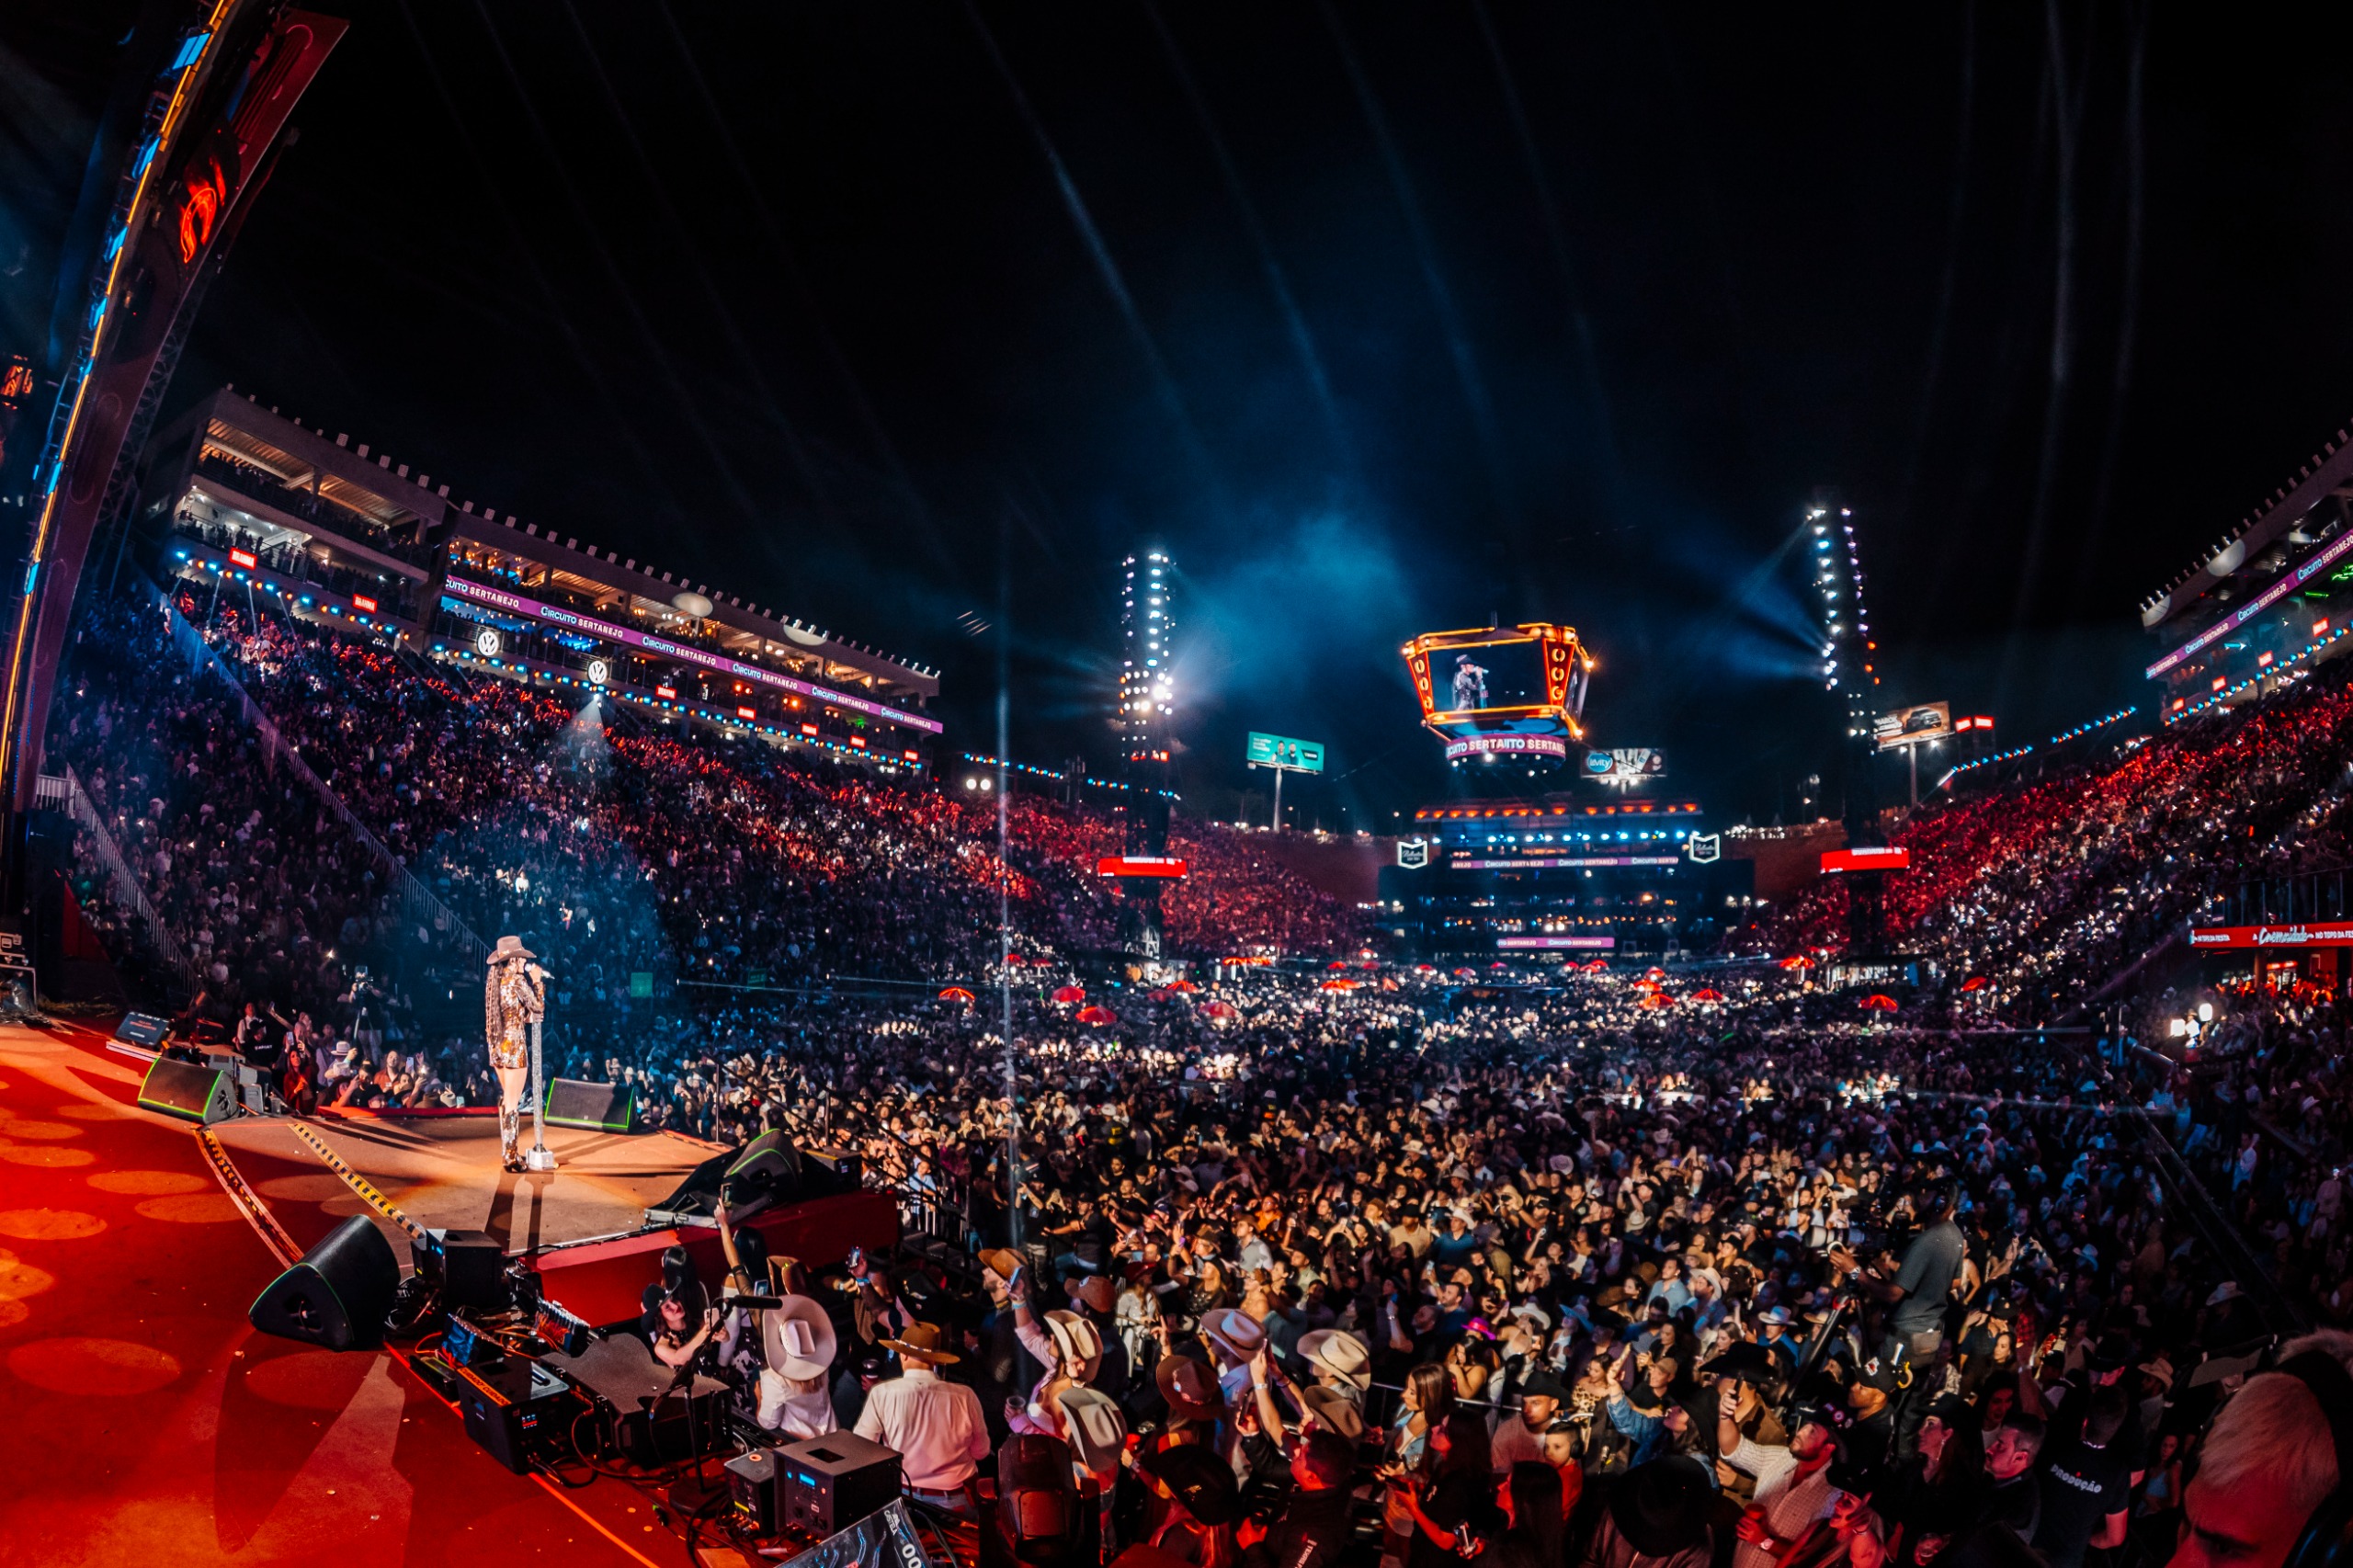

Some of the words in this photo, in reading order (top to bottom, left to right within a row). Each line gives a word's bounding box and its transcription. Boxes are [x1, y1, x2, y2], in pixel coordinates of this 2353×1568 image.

[469, 585, 519, 608] SERTANEJO
[540, 606, 577, 625] CIRCUITO
[577, 618, 623, 638] SERTANEJO
[642, 636, 676, 654] CIRCUITO
[676, 647, 716, 665] SERTANEJO
[733, 663, 762, 679] CIRCUITO
[762, 674, 798, 690] SERTANEJO
[812, 686, 837, 702] CIRCUITO
[837, 695, 870, 710] SERTANEJO
[904, 715, 932, 730] SERTANEJO
[2051, 1463, 2102, 1494] PRODUÇÃO
